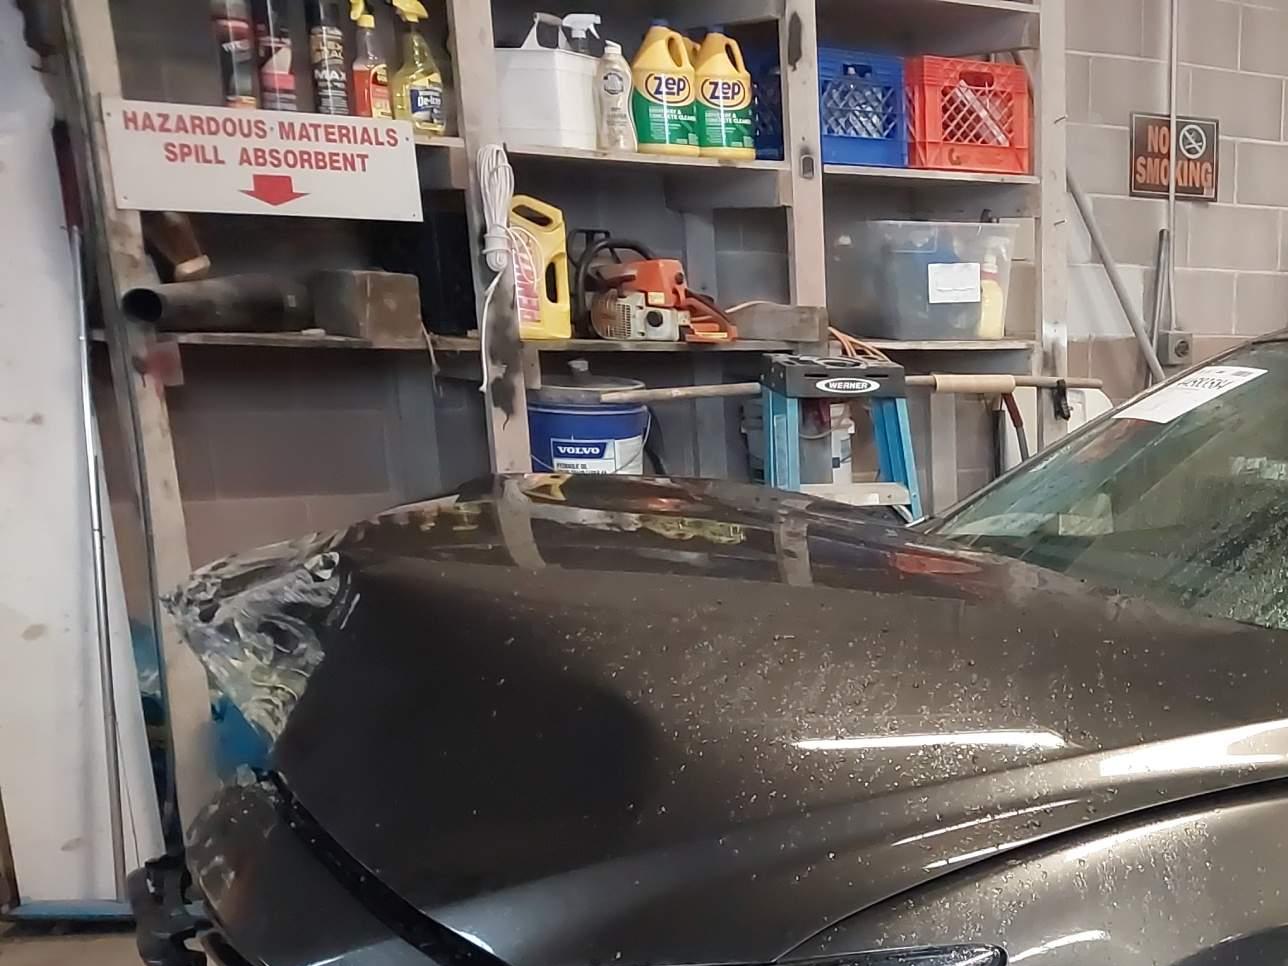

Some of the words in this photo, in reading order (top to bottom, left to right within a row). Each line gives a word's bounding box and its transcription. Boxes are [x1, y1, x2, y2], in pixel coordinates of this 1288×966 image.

[314, 69, 347, 81] MAX
[123, 110, 268, 139] HAZARDOUS
[279, 121, 400, 147] MATERIALS
[1147, 125, 1171, 155] NO
[163, 142, 226, 166] SPILL
[238, 148, 370, 172] ABSORBENT
[1135, 156, 1213, 188] SMOKING
[829, 382, 869, 390] WERNER
[557, 446, 601, 455] VOLVO
